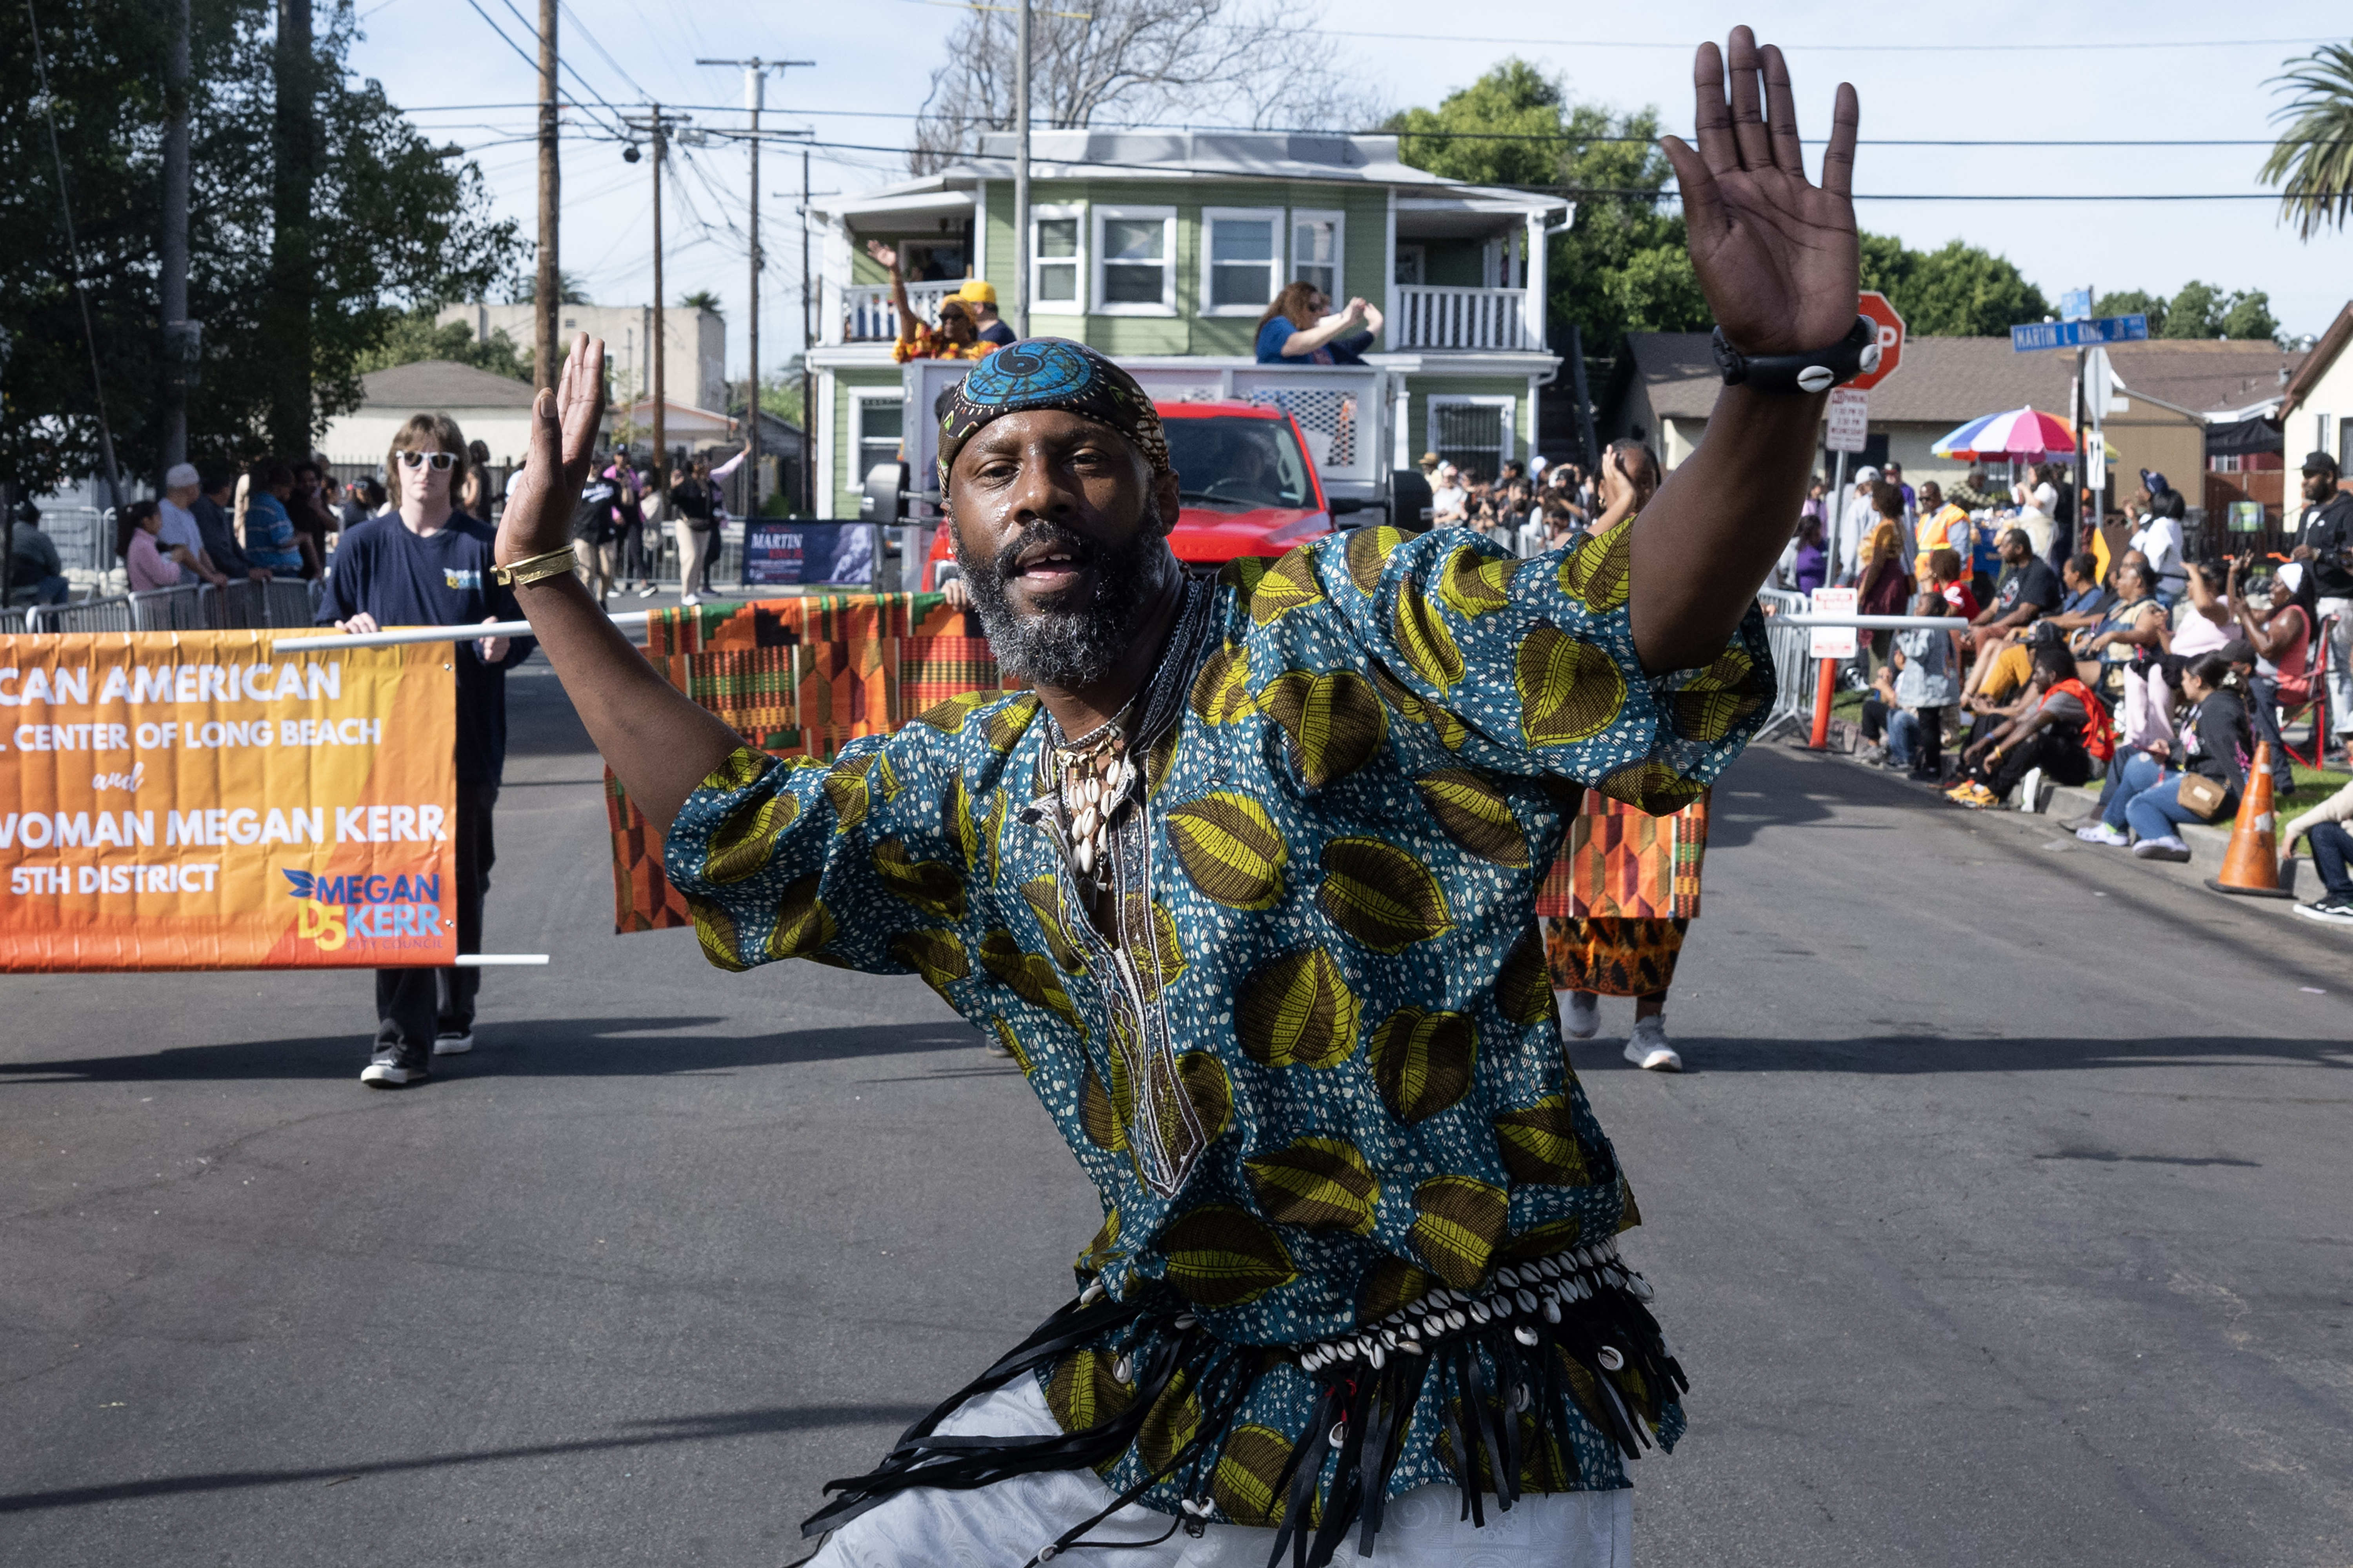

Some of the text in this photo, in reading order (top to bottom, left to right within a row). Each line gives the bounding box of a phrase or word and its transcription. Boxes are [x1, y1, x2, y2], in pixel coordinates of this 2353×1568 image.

[2017, 326, 2057, 348] MARTIN
[2063, 324, 2071, 344] L
[751, 533, 803, 549] MARTIN
[100, 662, 341, 705] AMERICAN
[14, 718, 381, 751] CENTER OF LONG BEACH
[93, 762, 144, 792] and
[166, 808, 322, 846] MEGAN
[336, 805, 447, 843] KERR
[11, 863, 219, 895] 5TH DISTRICT
[316, 874, 439, 904] MEGAN
[298, 899, 443, 951] D5 KERR
[347, 939, 442, 950] CITY COUNCIL
